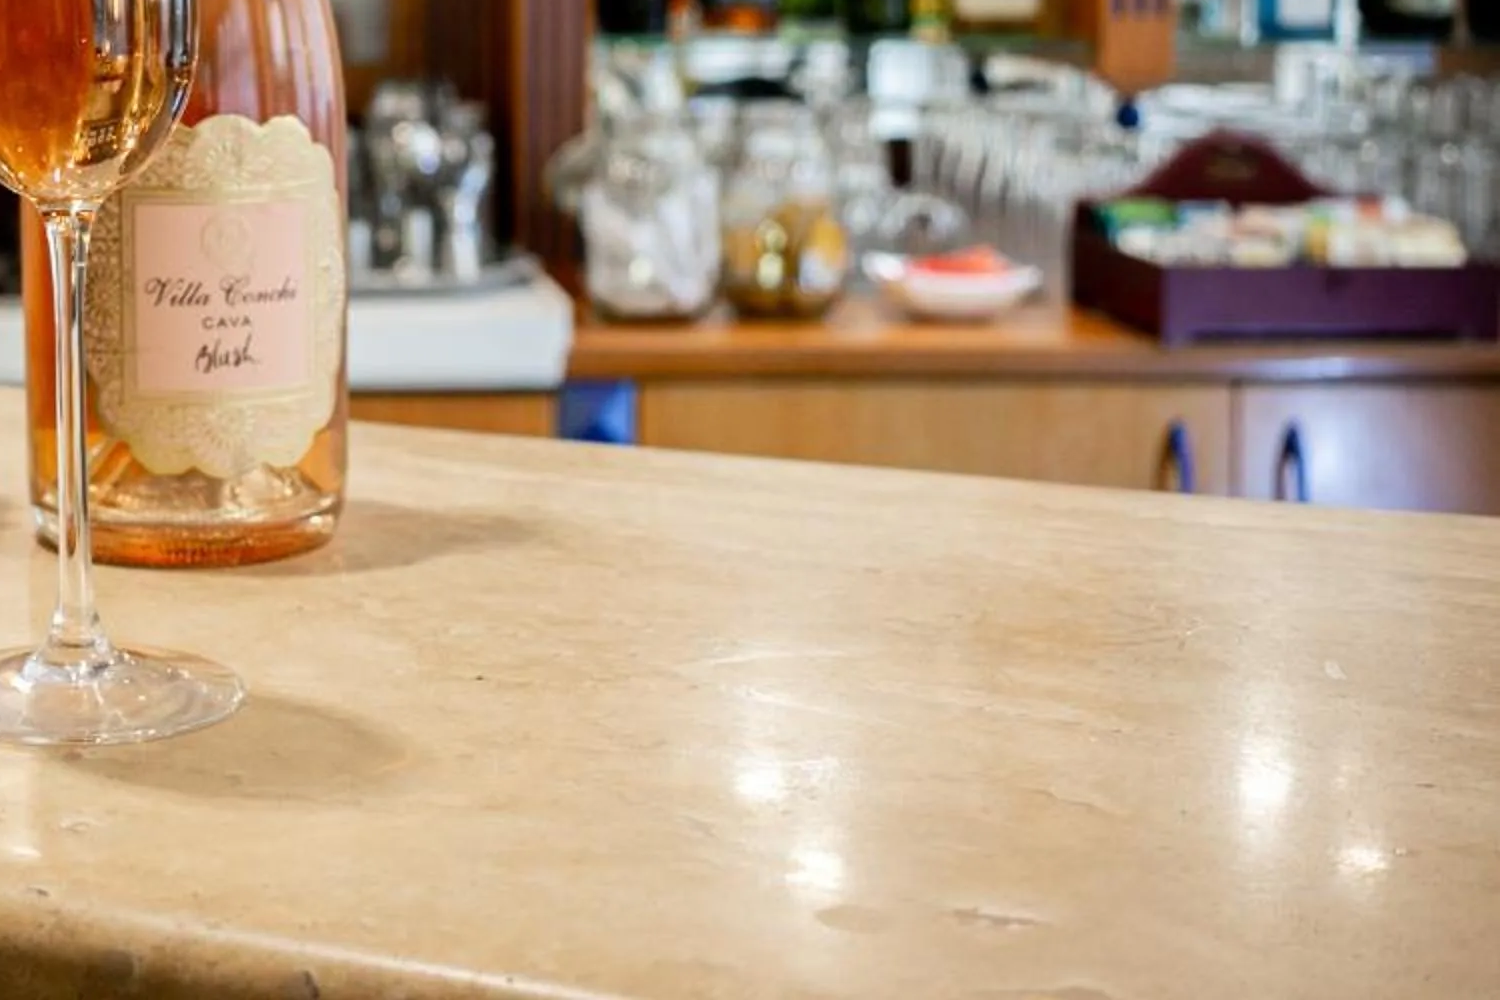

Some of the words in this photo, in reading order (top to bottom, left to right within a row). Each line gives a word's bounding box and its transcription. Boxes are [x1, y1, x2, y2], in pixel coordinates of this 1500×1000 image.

[144, 277, 211, 307] Villa
[219, 274, 297, 306] Conchi
[201, 315, 252, 330] CAVA
[195, 332, 262, 374] Blush
